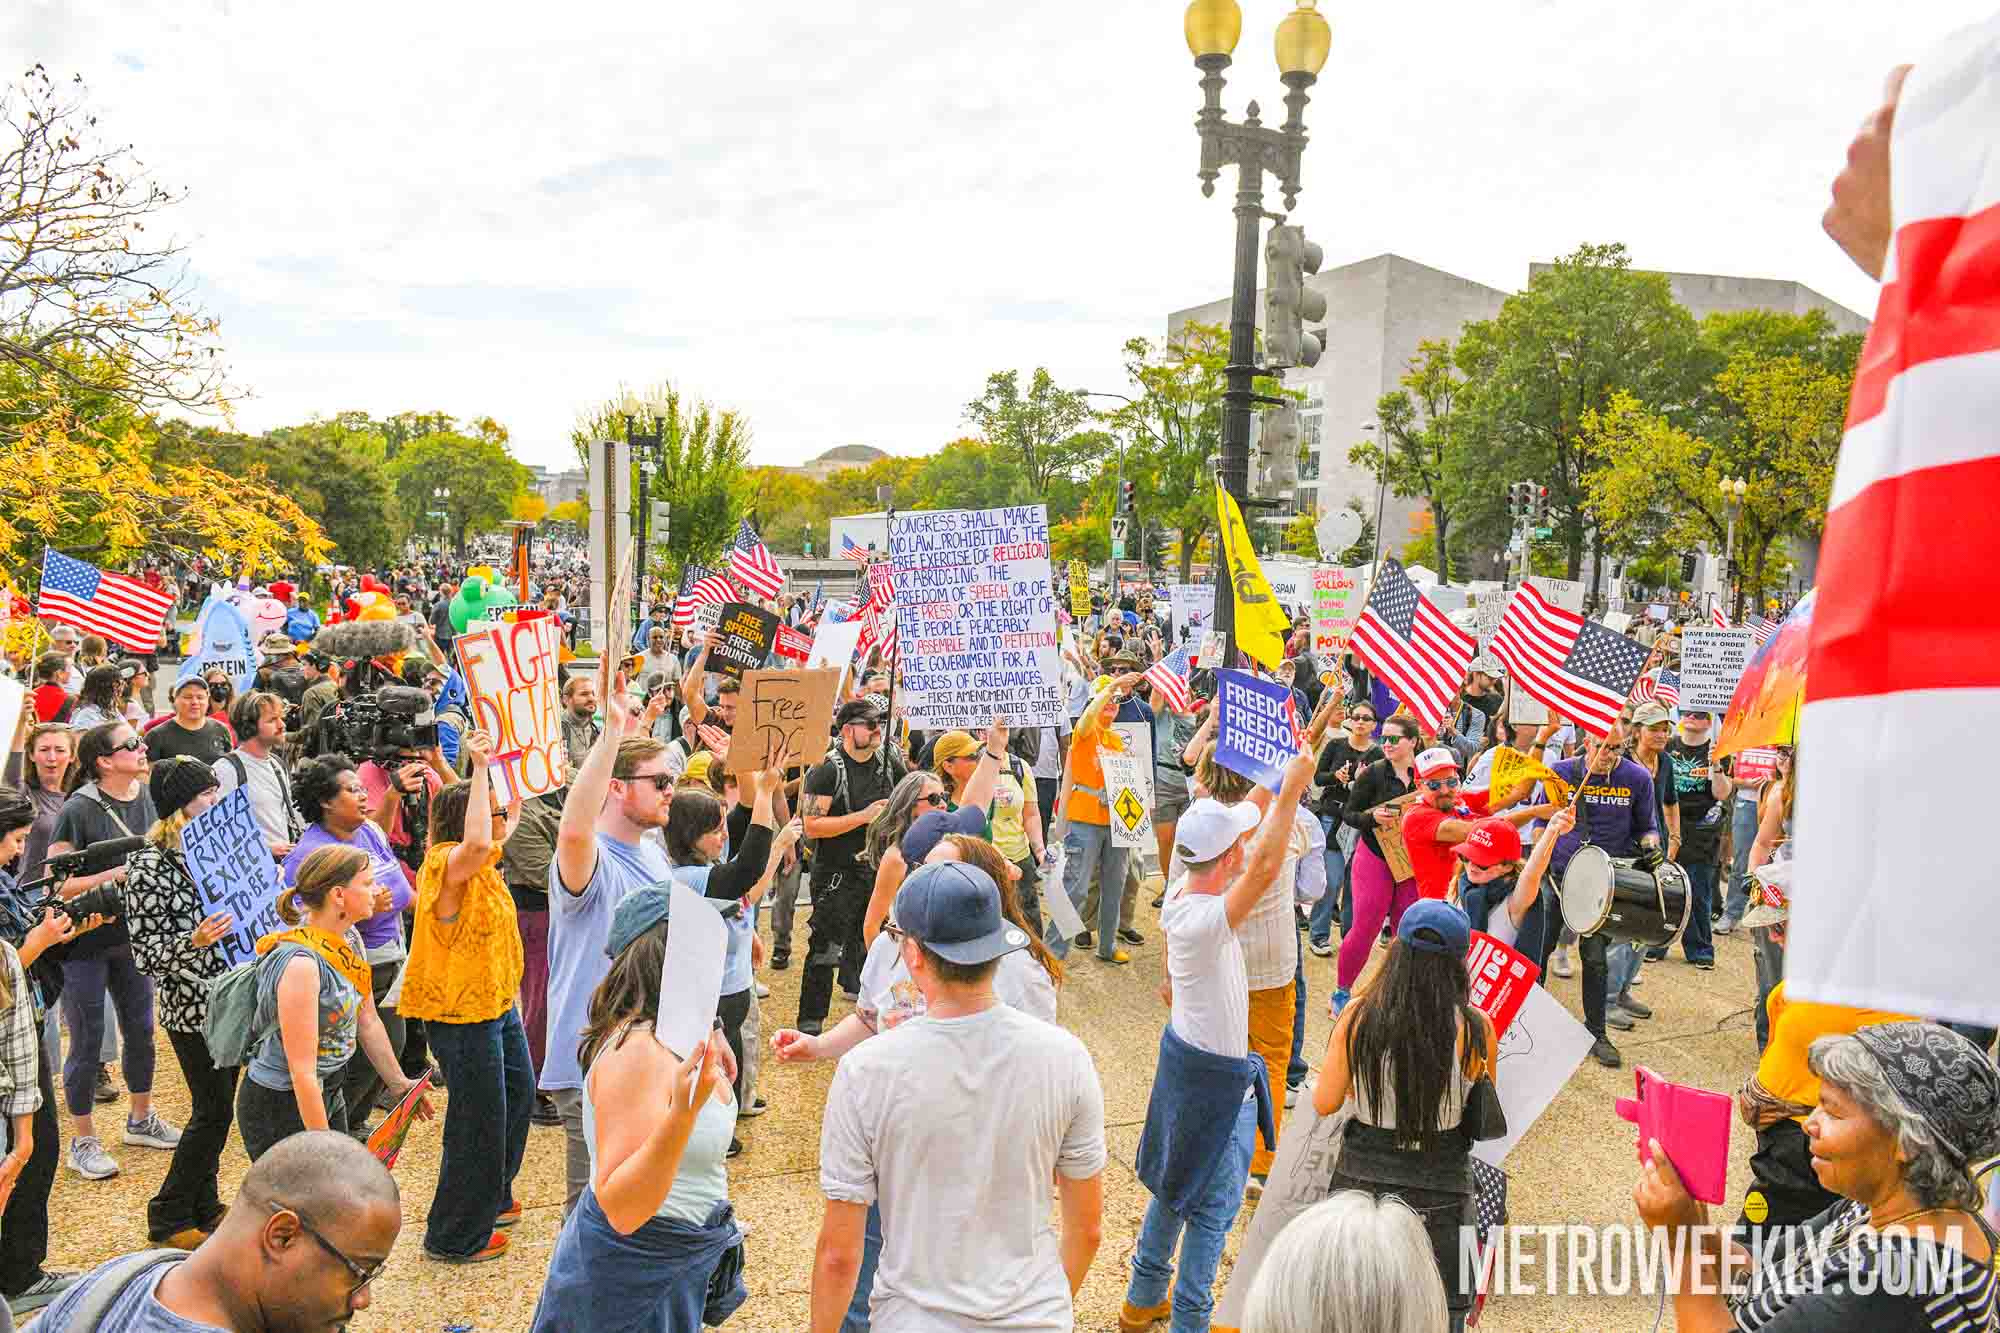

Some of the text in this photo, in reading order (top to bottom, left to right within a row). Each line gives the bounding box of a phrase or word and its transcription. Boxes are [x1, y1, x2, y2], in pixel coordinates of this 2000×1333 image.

[889, 506, 1040, 536] CONGRESS SHALL MAKE
[890, 536, 907, 554] NO
[1024, 525, 1048, 542] THE
[892, 554, 916, 572] FREE
[920, 551, 972, 569] EXERCISE
[894, 564, 1011, 588] OR ABRIDGING THE
[1546, 580, 1569, 592] THIS
[896, 587, 949, 606] FREEDOM
[952, 586, 966, 601] OF
[1013, 582, 1029, 596] OR
[1031, 580, 1048, 596] OF
[736, 611, 763, 630] FREE
[896, 606, 919, 622] THE
[958, 602, 974, 618] OR
[975, 601, 999, 616] THE
[1001, 598, 1035, 615] RIGHT
[1038, 596, 1053, 613] OF
[898, 618, 1031, 638] THE PEOPLE PEACEABLY
[1705, 631, 1753, 639] DEMOCRACY
[727, 634, 754, 654] FREE
[900, 631, 1056, 655] TO ASSEMBLE AND TO PETITION
[713, 644, 761, 669] COUNTRY
[902, 650, 1037, 673] THE GOVERNMENT FOR A
[903, 673, 952, 692] REDRESS
[956, 672, 970, 689] OF
[956, 688, 1014, 702] AMENDMENT
[1018, 687, 1033, 700] OF
[1036, 686, 1058, 700] THE
[752, 678, 808, 728] Free
[906, 700, 1063, 717] CONSTITUTION OF THE UNITED STATES
[1225, 680, 1289, 724] FREEDO
[929, 716, 969, 727] RATIFIED
[1036, 712, 1062, 725] 1791
[1225, 725, 1297, 770] FREEDO
[1600, 795, 1631, 806] LIVES
[193, 805, 255, 874] RAPIST
[201, 830, 267, 904] EXPECT
[220, 902, 281, 966] FUCKE
[1482, 949, 1509, 982] DC
